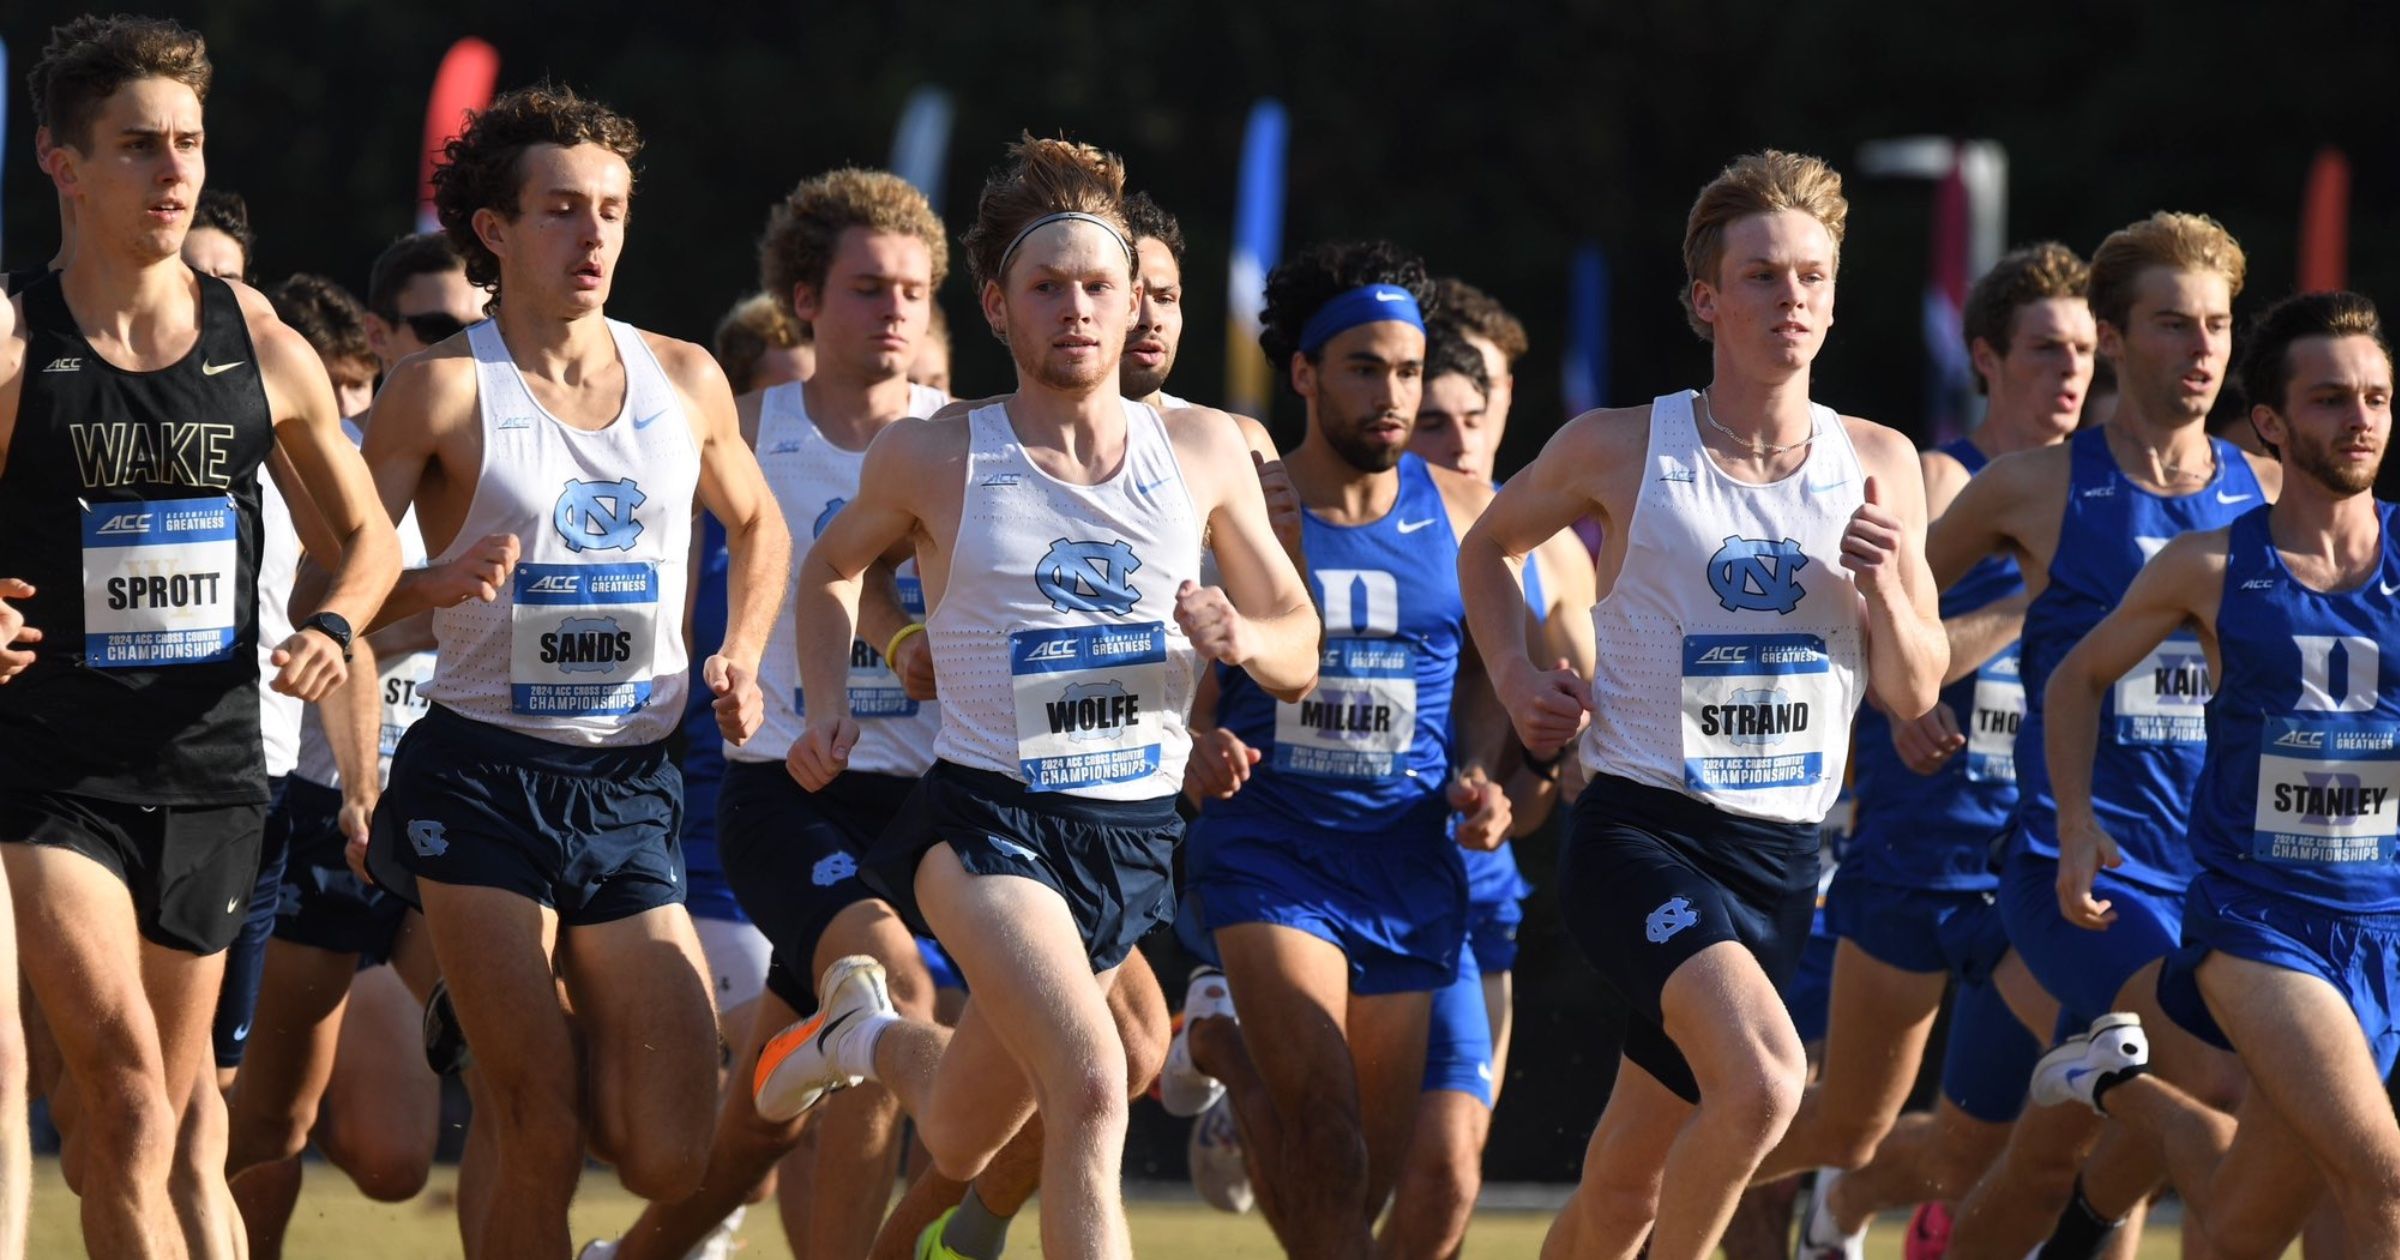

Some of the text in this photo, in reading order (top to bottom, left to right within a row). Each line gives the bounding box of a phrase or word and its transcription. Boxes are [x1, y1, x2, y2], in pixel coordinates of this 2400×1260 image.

[45, 358, 82, 371] ACC
[499, 416, 532, 429] ACC
[69, 422, 234, 489] WAKE
[982, 473, 1021, 486] ACC
[98, 514, 152, 532] ACC
[166, 517, 225, 532] GREATNESS
[107, 572, 220, 611] SPROTT
[528, 576, 580, 592] ACC
[591, 580, 646, 593] GREATNESS
[2241, 579, 2275, 590] ACC
[1314, 569, 1398, 638] D
[108, 635, 132, 646] 2024
[135, 634, 153, 645] ACC
[156, 632, 184, 644] CROSS
[540, 631, 631, 663] SANDS
[1092, 639, 1151, 656] GREATNESS
[107, 641, 222, 661] CHAMPIONSHIPS
[1026, 639, 1079, 660] ACC
[1697, 646, 1750, 663] ACC
[1762, 650, 1818, 664] GREATNESS
[2292, 635, 2379, 712] D
[531, 686, 553, 696] 2024
[555, 686, 571, 696] ACC
[529, 694, 635, 710] CHAMPIONSHIPS
[1046, 694, 1139, 734] WOLFE
[1301, 701, 1390, 732] MILLER
[1701, 702, 1809, 736] STRAND
[2275, 730, 2325, 747] ACC
[2336, 738, 2394, 750] GREATNESS
[1041, 750, 1145, 771] 2024 ACC CROSS COUNTRY
[1703, 759, 1725, 770] 2024
[1727, 759, 1743, 769] ACC
[1745, 758, 1772, 769] CROSS
[1040, 758, 1146, 785] CHAMPIONSHIPS
[1703, 765, 1805, 784] CHAMPIONSHIPS
[2274, 783, 2388, 817] STANLEY
[2274, 834, 2296, 846] 2024
[2298, 836, 2315, 847] ACC
[2272, 844, 2379, 862] CHAMPIONSHIPS
